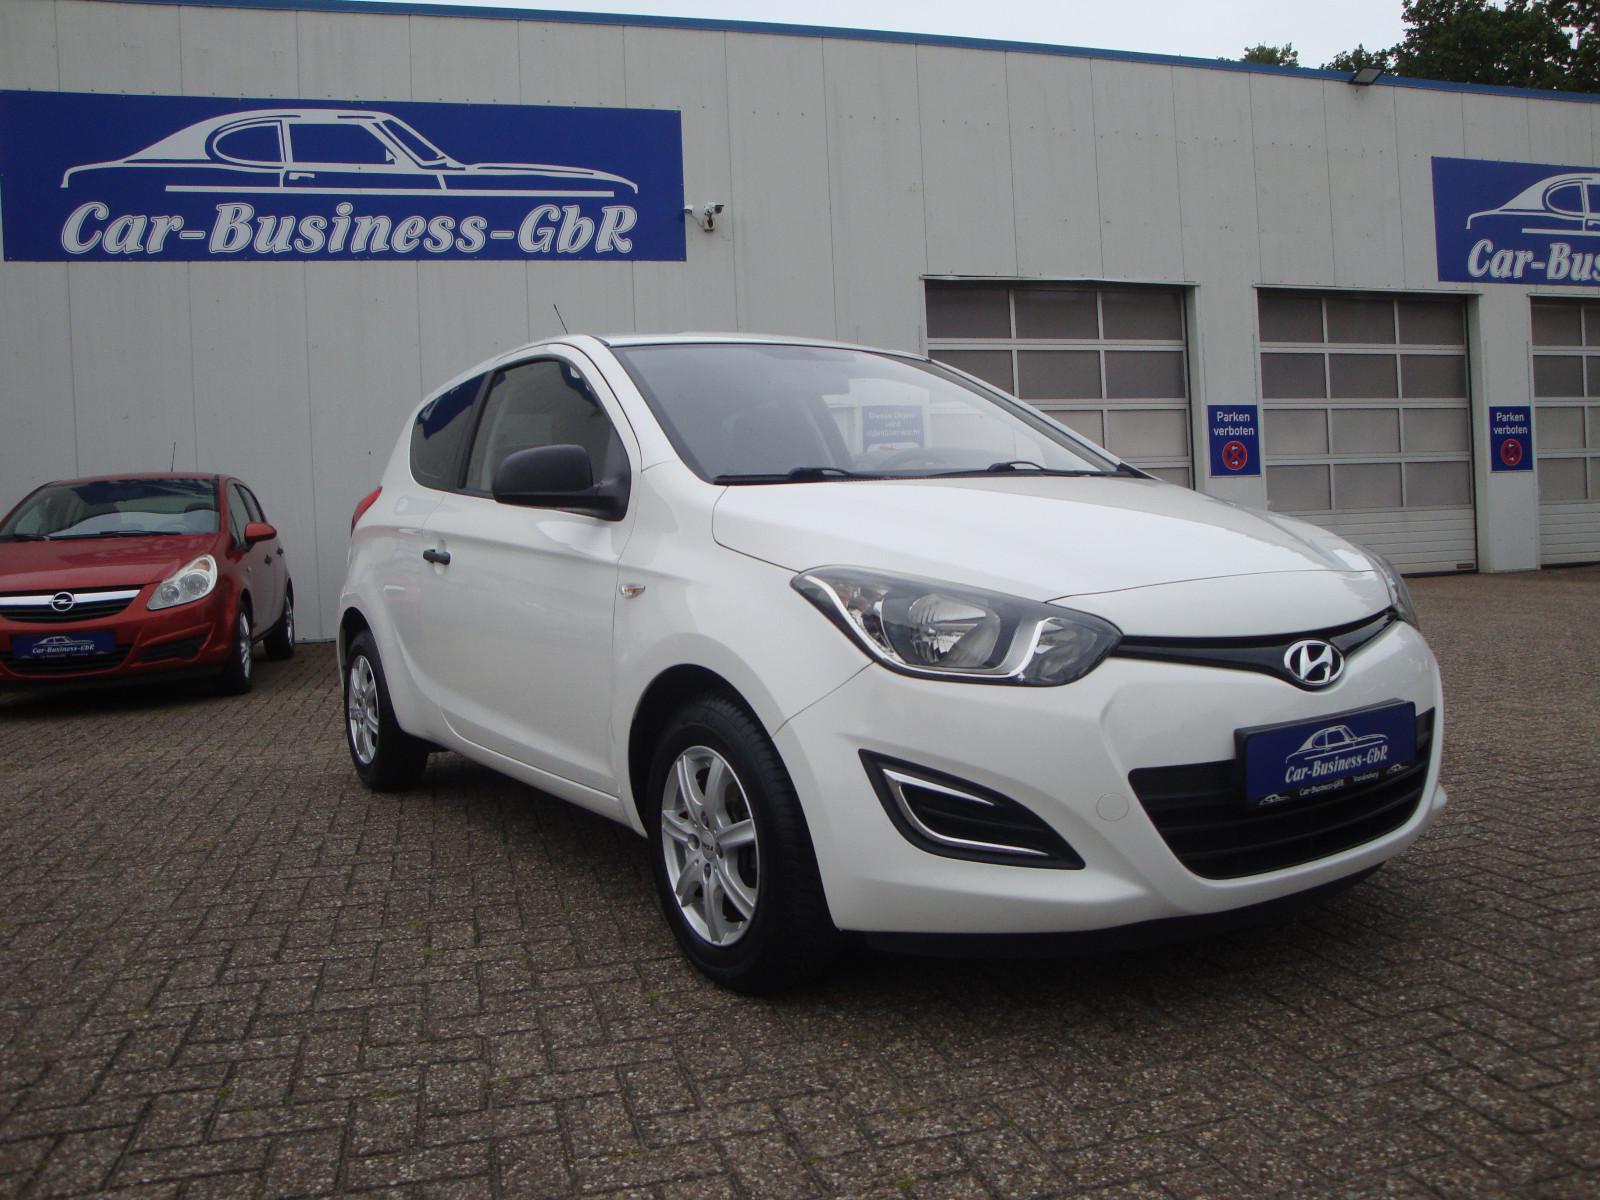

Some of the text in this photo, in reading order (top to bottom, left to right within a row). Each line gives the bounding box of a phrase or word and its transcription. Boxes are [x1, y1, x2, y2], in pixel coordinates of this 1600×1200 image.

[60, 201, 638, 255] Car-Business-GbR
[1216, 411, 1250, 422] Parken
[1496, 412, 1524, 422] Parken
[1213, 425, 1254, 436] verboten
[1493, 425, 1528, 435] verboten
[1285, 744, 1388, 783] Car-Business-GbR
